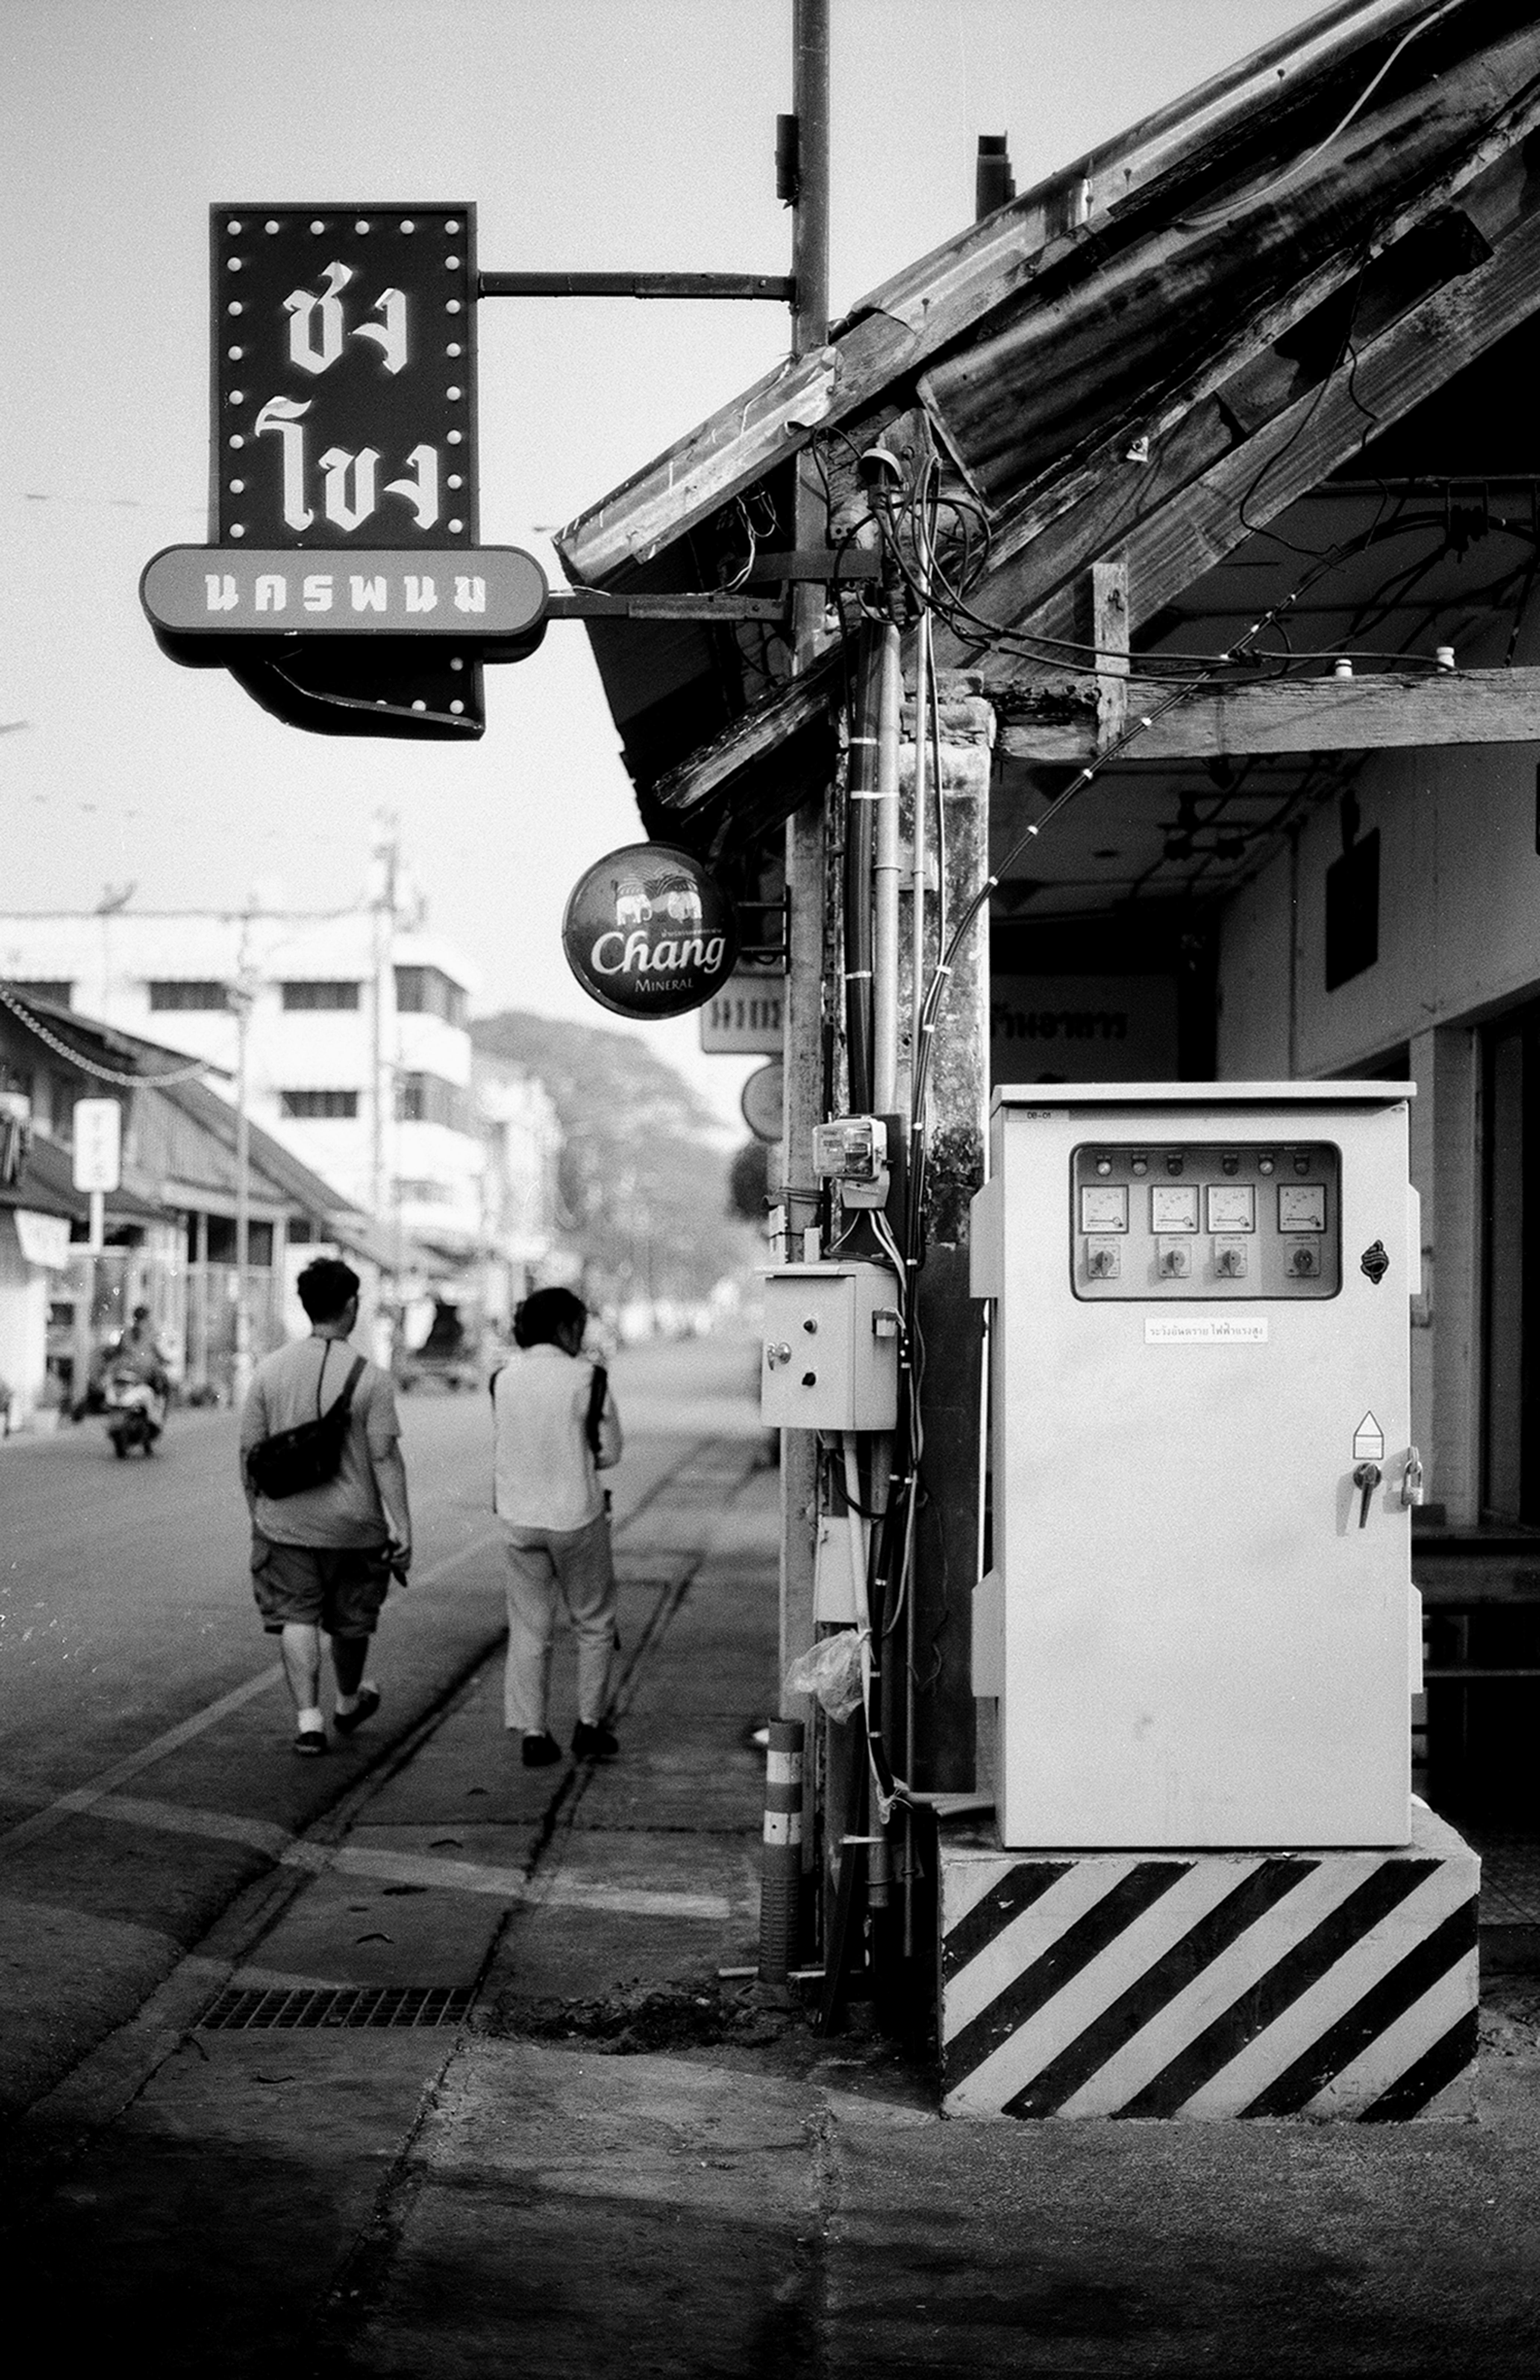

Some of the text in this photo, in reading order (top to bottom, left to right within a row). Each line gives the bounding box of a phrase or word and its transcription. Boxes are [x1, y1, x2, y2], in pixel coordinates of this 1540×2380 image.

[254, 395, 439, 532] โขง
[205, 574, 487, 613] นครพนม
[591, 930, 726, 975] Chang
[991, 1003, 1129, 1039] ้านอาหาร
